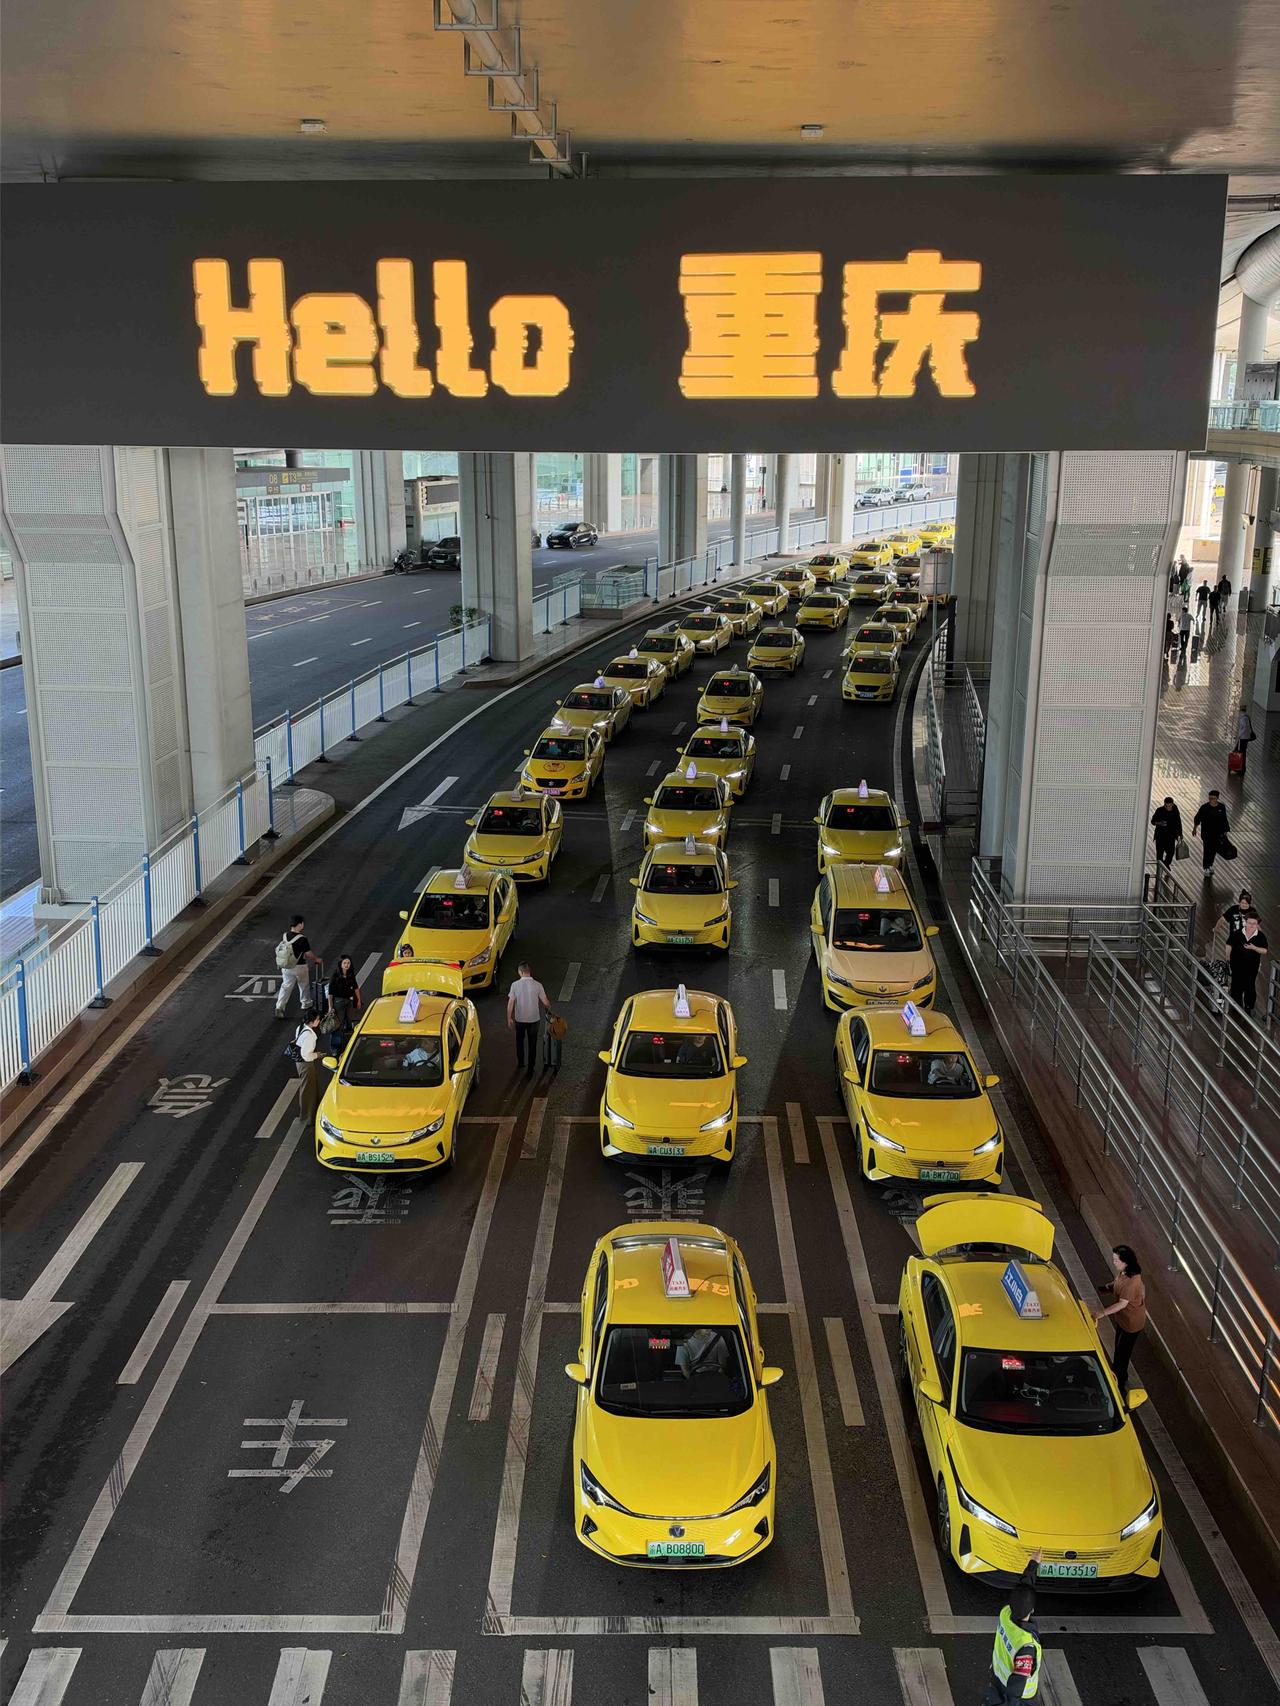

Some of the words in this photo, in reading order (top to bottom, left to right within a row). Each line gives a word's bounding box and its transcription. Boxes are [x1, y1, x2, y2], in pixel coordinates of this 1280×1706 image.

[192, 257, 574, 398] Hello
[678, 249, 982, 399] 重庆
[227, 1400, 348, 1494] 车
[666, 1543, 704, 1555] B08800
[1058, 1565, 1096, 1577] CY3519
